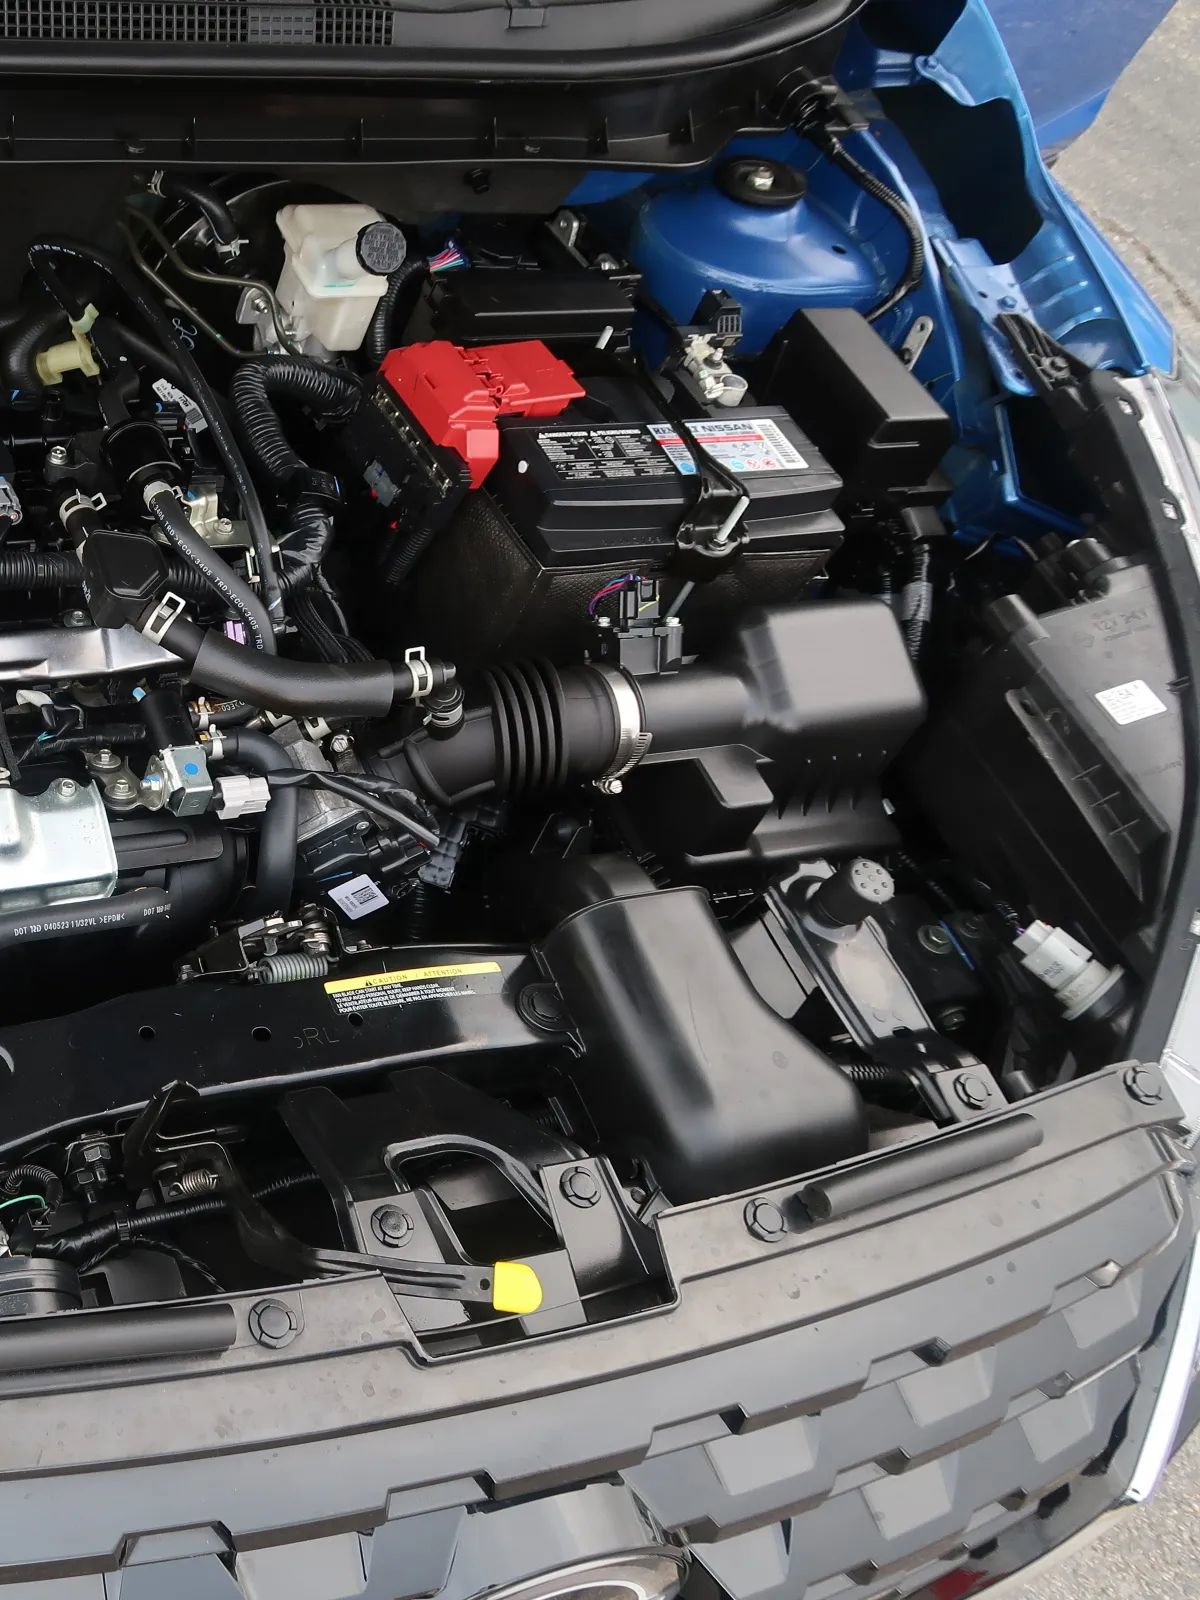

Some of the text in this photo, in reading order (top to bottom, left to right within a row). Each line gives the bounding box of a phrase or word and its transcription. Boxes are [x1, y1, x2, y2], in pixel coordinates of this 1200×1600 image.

[702, 424, 752, 432] NISSAN
[14, 927, 27, 936] DOT
[43, 921, 69, 931] 040523
[99, 912, 125, 924] >EPDM<
[372, 974, 408, 984] CAUTION
[423, 968, 463, 977] ATTENTION
[342, 998, 373, 1007] VENTILATEUR
